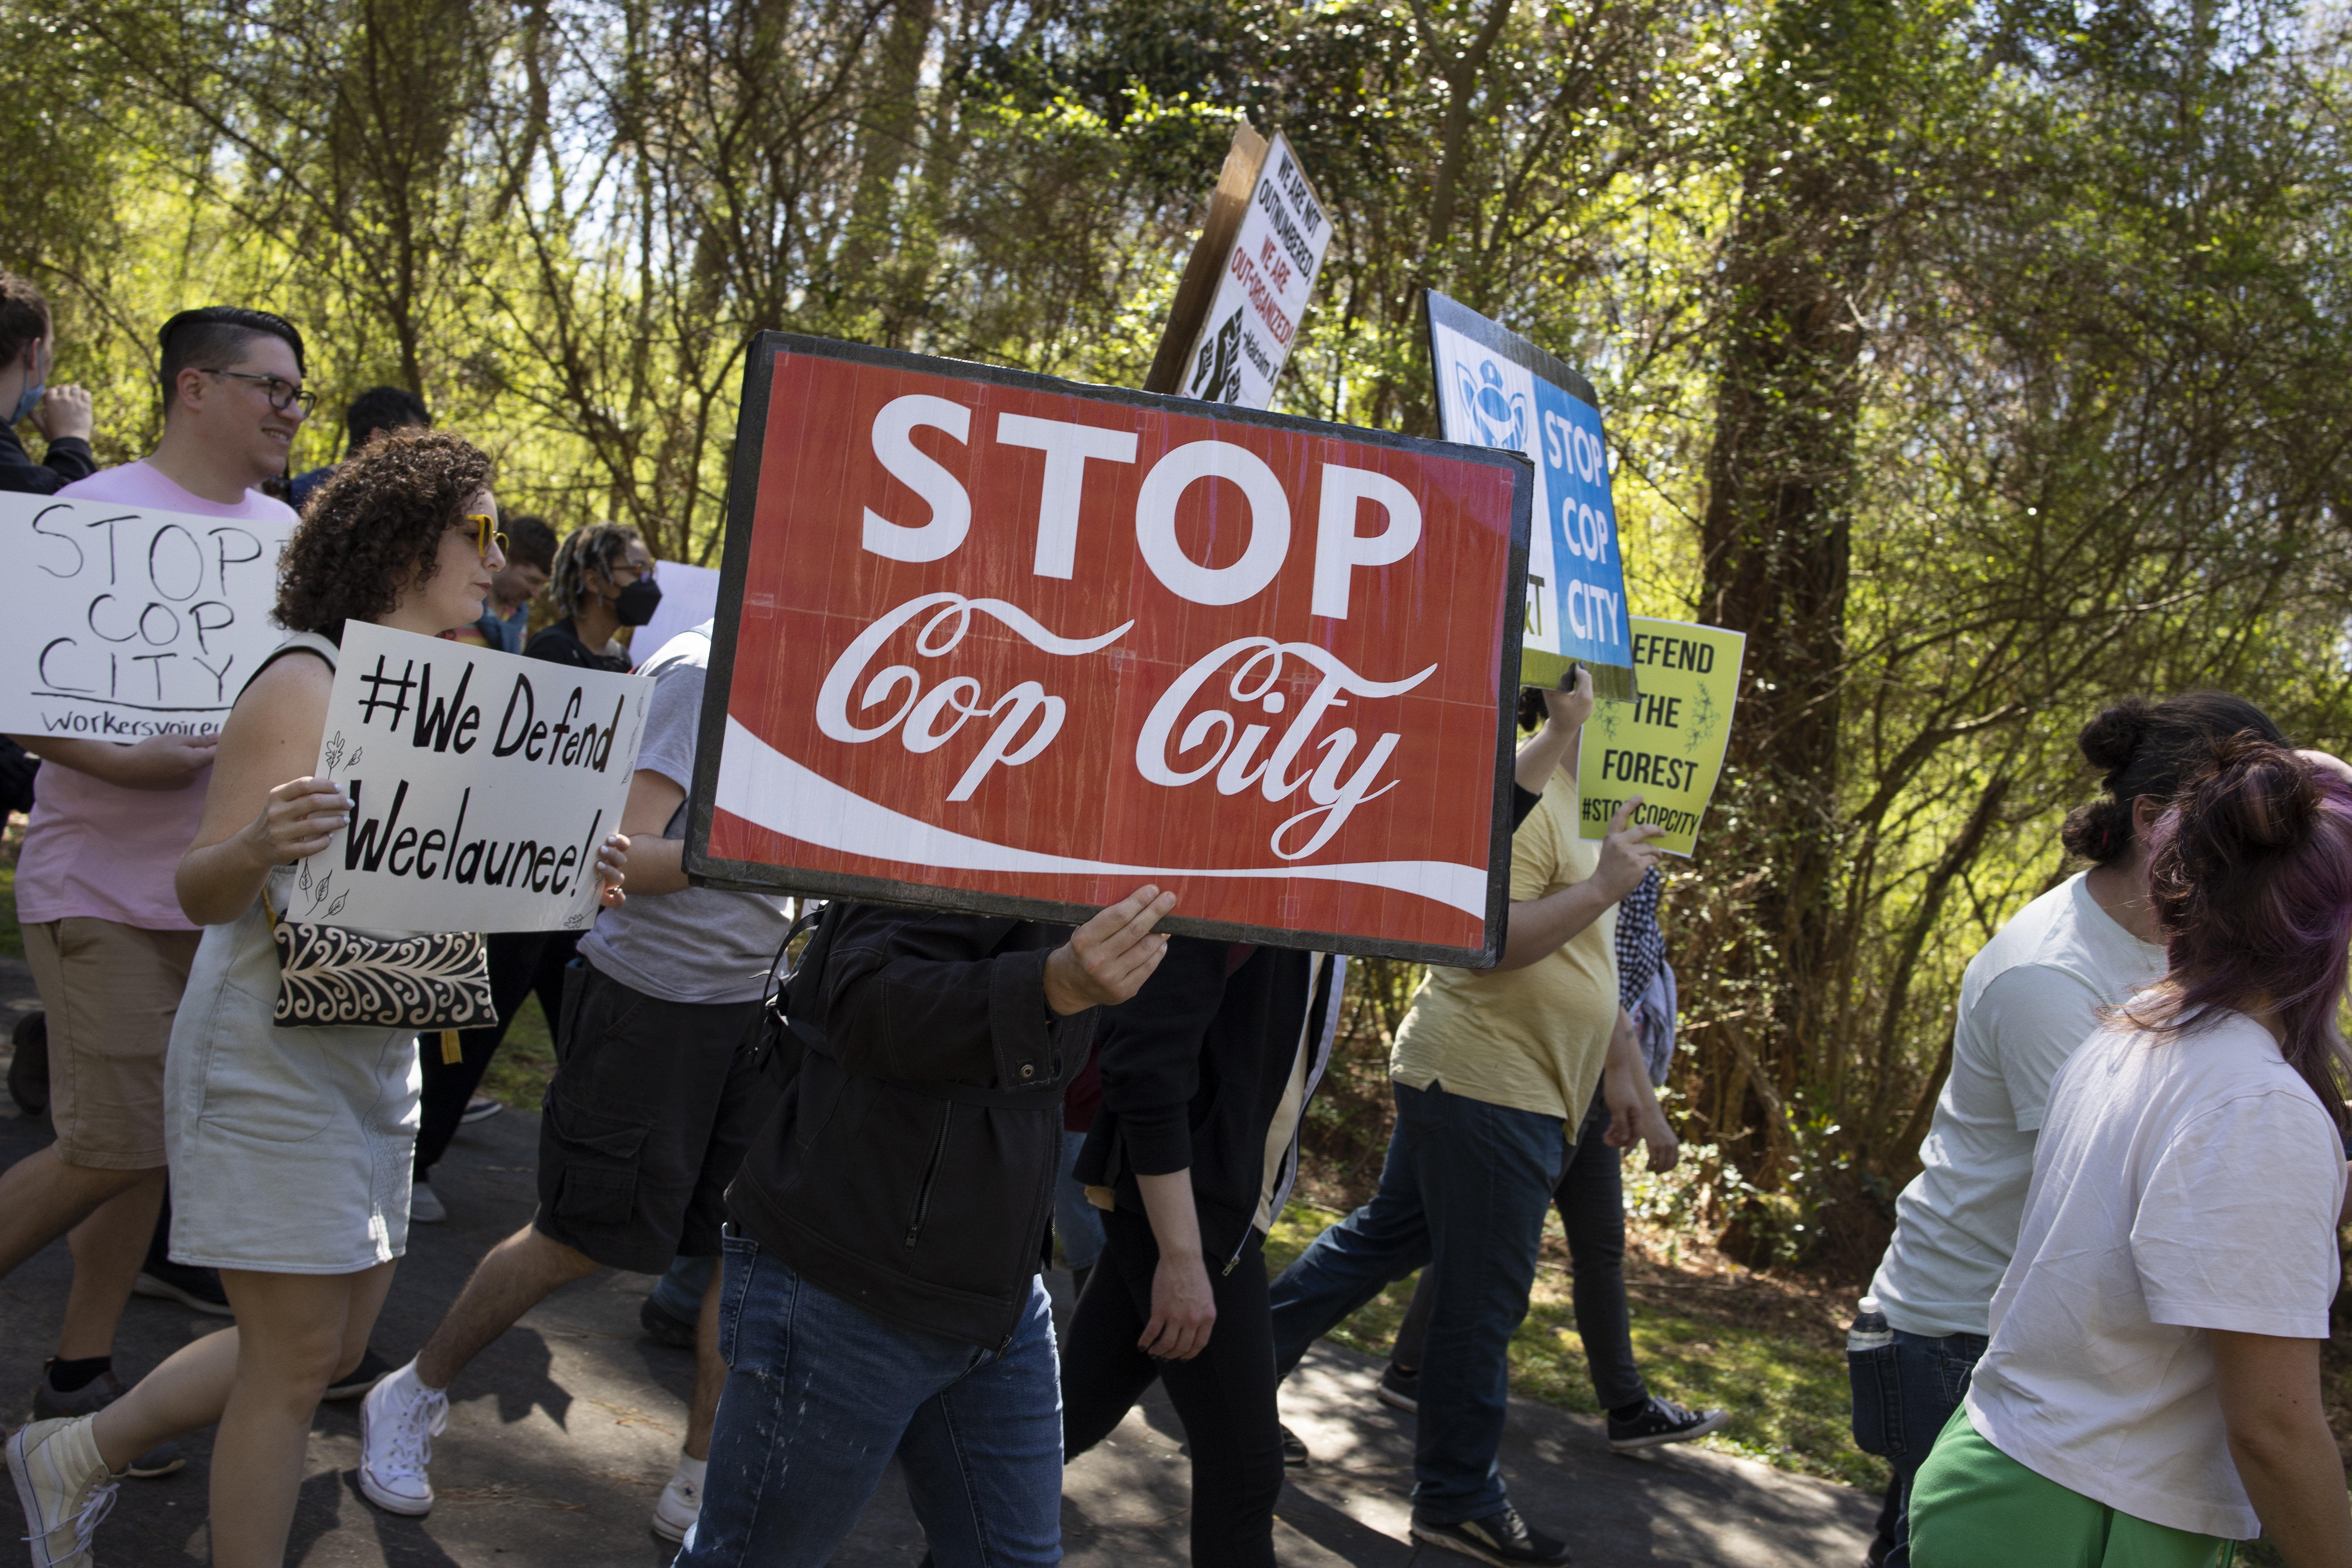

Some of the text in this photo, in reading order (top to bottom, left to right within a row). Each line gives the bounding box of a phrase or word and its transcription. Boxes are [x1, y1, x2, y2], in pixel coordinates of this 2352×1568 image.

[1278, 151, 1321, 238] WE ARE NOT
[1259, 178, 1313, 285] OUTNUMBERED,
[1260, 234, 1290, 294] WE ARE
[1268, 363, 1279, 386] X
[1545, 410, 1602, 487] STOP
[861, 393, 1422, 620] STOP
[1563, 497, 1608, 564] COP
[33, 504, 262, 601] STOP
[89, 594, 234, 655] COP
[1568, 579, 1619, 645] CITY
[39, 637, 233, 701] CITY
[1633, 634, 1714, 674] EFEND
[358, 655, 625, 773] #We Defend
[816, 591, 1438, 860] Cop City
[1633, 693, 1681, 728] THE
[1602, 749, 1698, 792] FOREST
[345, 779, 601, 897] Weelaunee!
[1583, 798, 1699, 836] #STOCOPCITY
